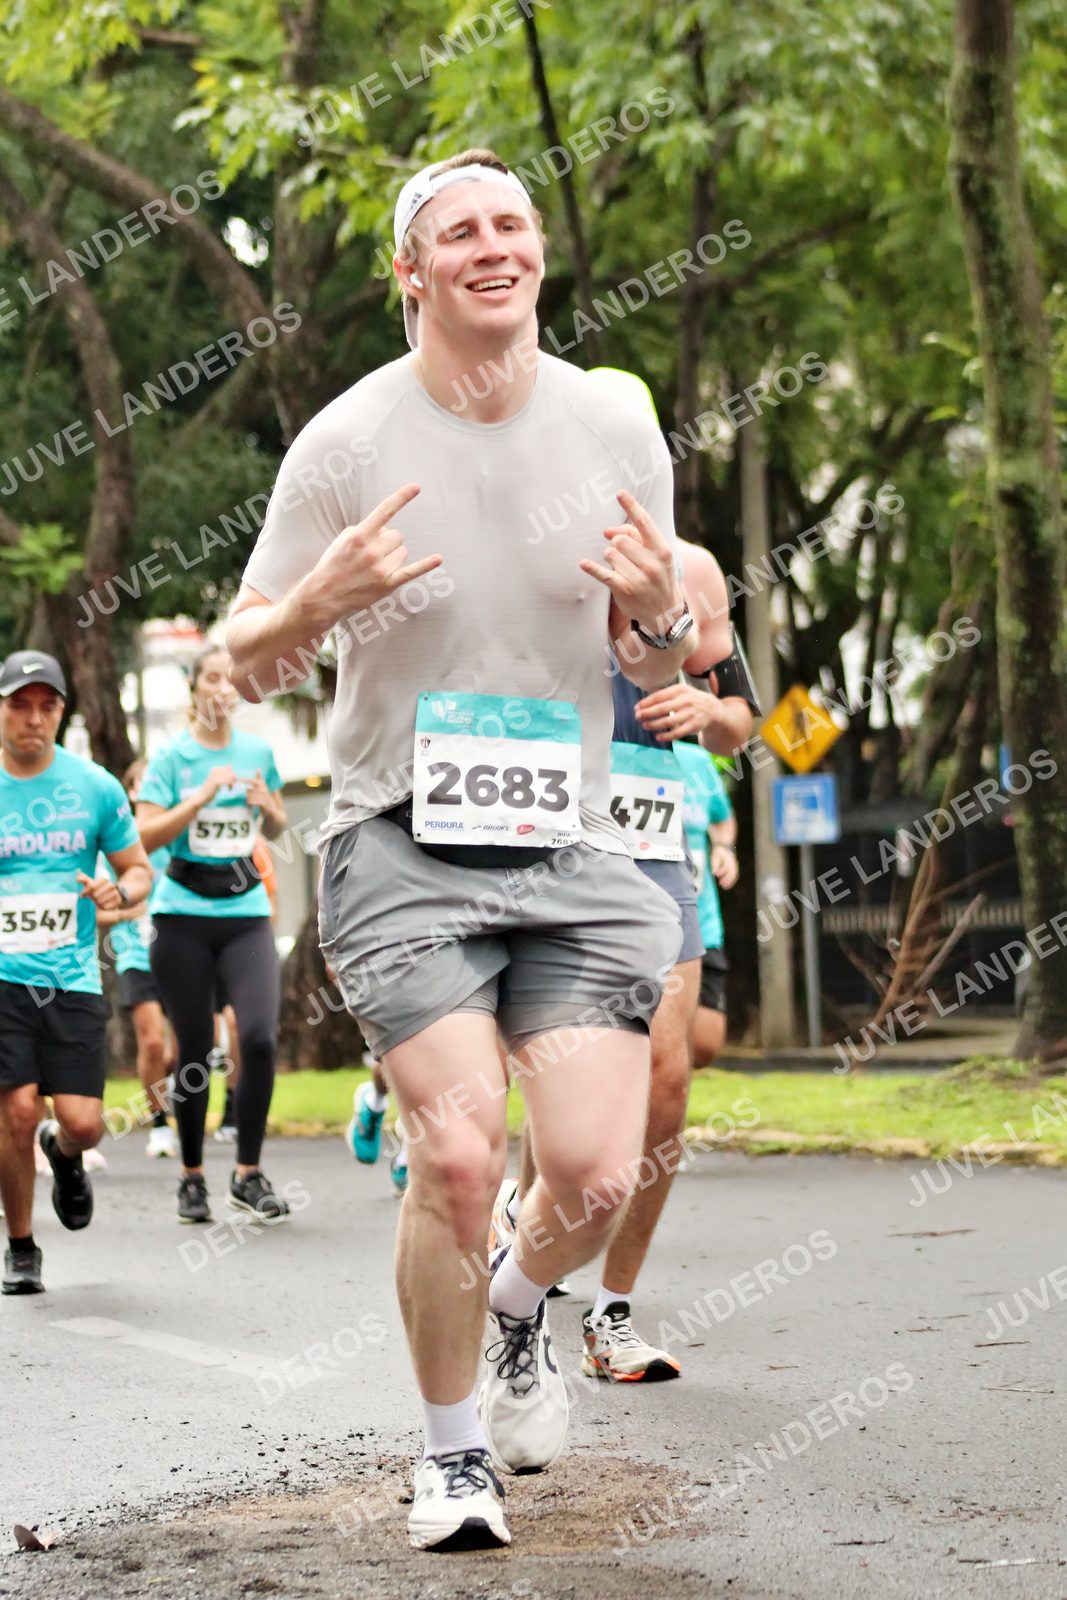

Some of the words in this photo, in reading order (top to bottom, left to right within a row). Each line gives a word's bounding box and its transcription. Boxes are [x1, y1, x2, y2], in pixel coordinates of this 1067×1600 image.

[427, 761, 570, 813] 2683
[425, 821, 464, 830] PERDURA
[610, 796, 675, 833] 477
[196, 820, 250, 839] 5759
[0, 829, 87, 858] RDURA
[2, 909, 72, 933] 3547
